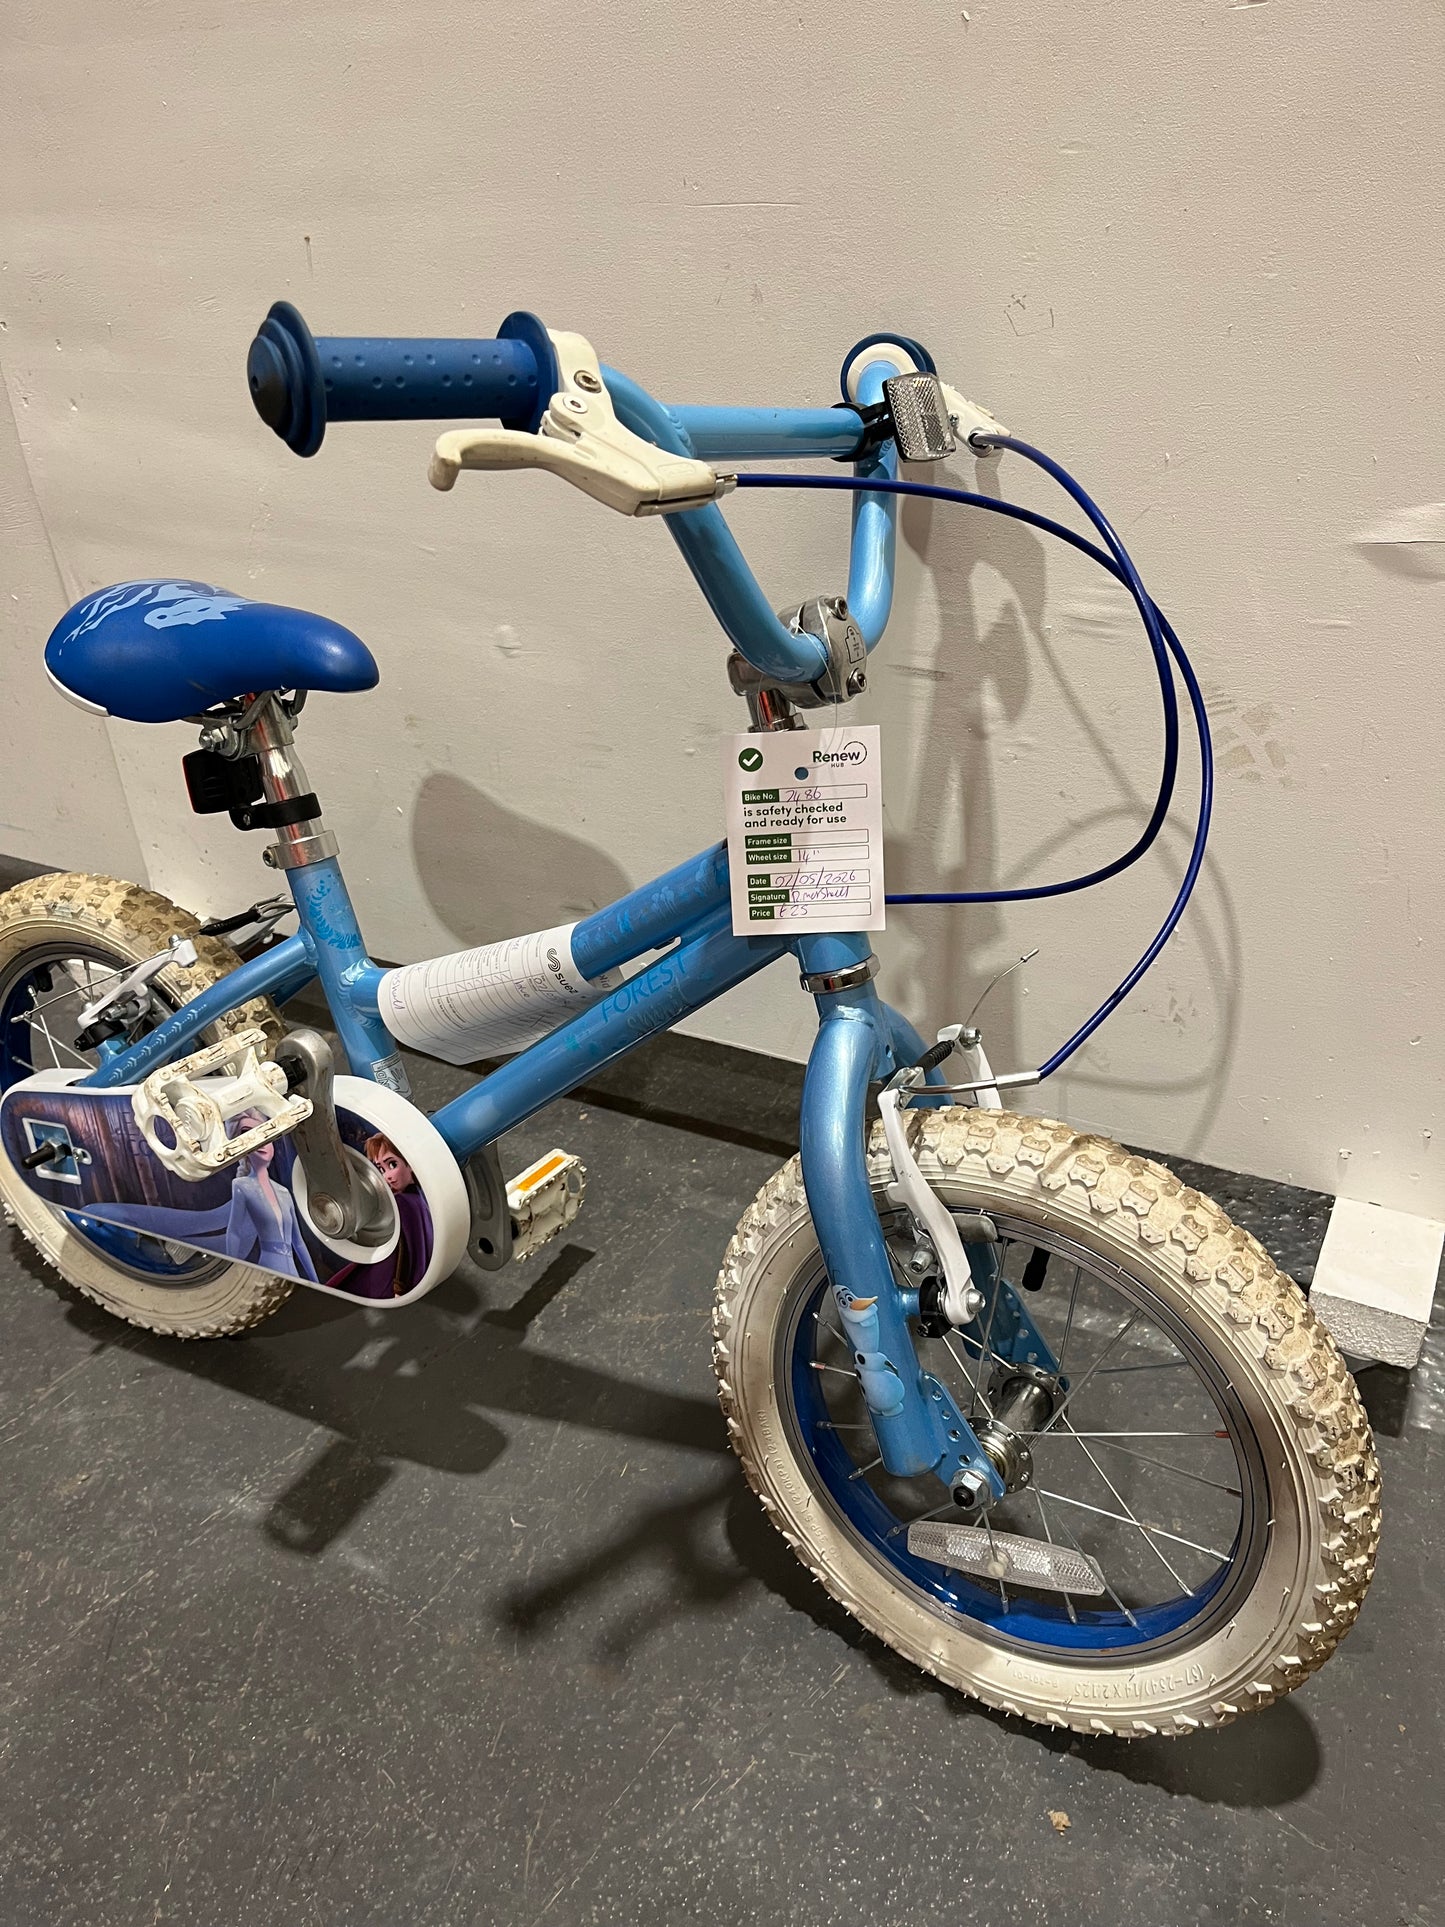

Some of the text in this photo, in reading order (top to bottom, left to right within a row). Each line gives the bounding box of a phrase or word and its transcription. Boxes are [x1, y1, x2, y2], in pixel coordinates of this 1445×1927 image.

[812, 750, 861, 763] Renew
[744, 793, 761, 801] Bike
[743, 802, 843, 817] is safety checked
[744, 814, 847, 828] and ready for use
[747, 837, 788, 846] Frame size
[748, 853, 788, 862] Wheel size
[749, 877, 767, 885] Date
[750, 892, 786, 902] Signature
[751, 908, 771, 918] Price
[600, 946, 690, 1024] FOREST
